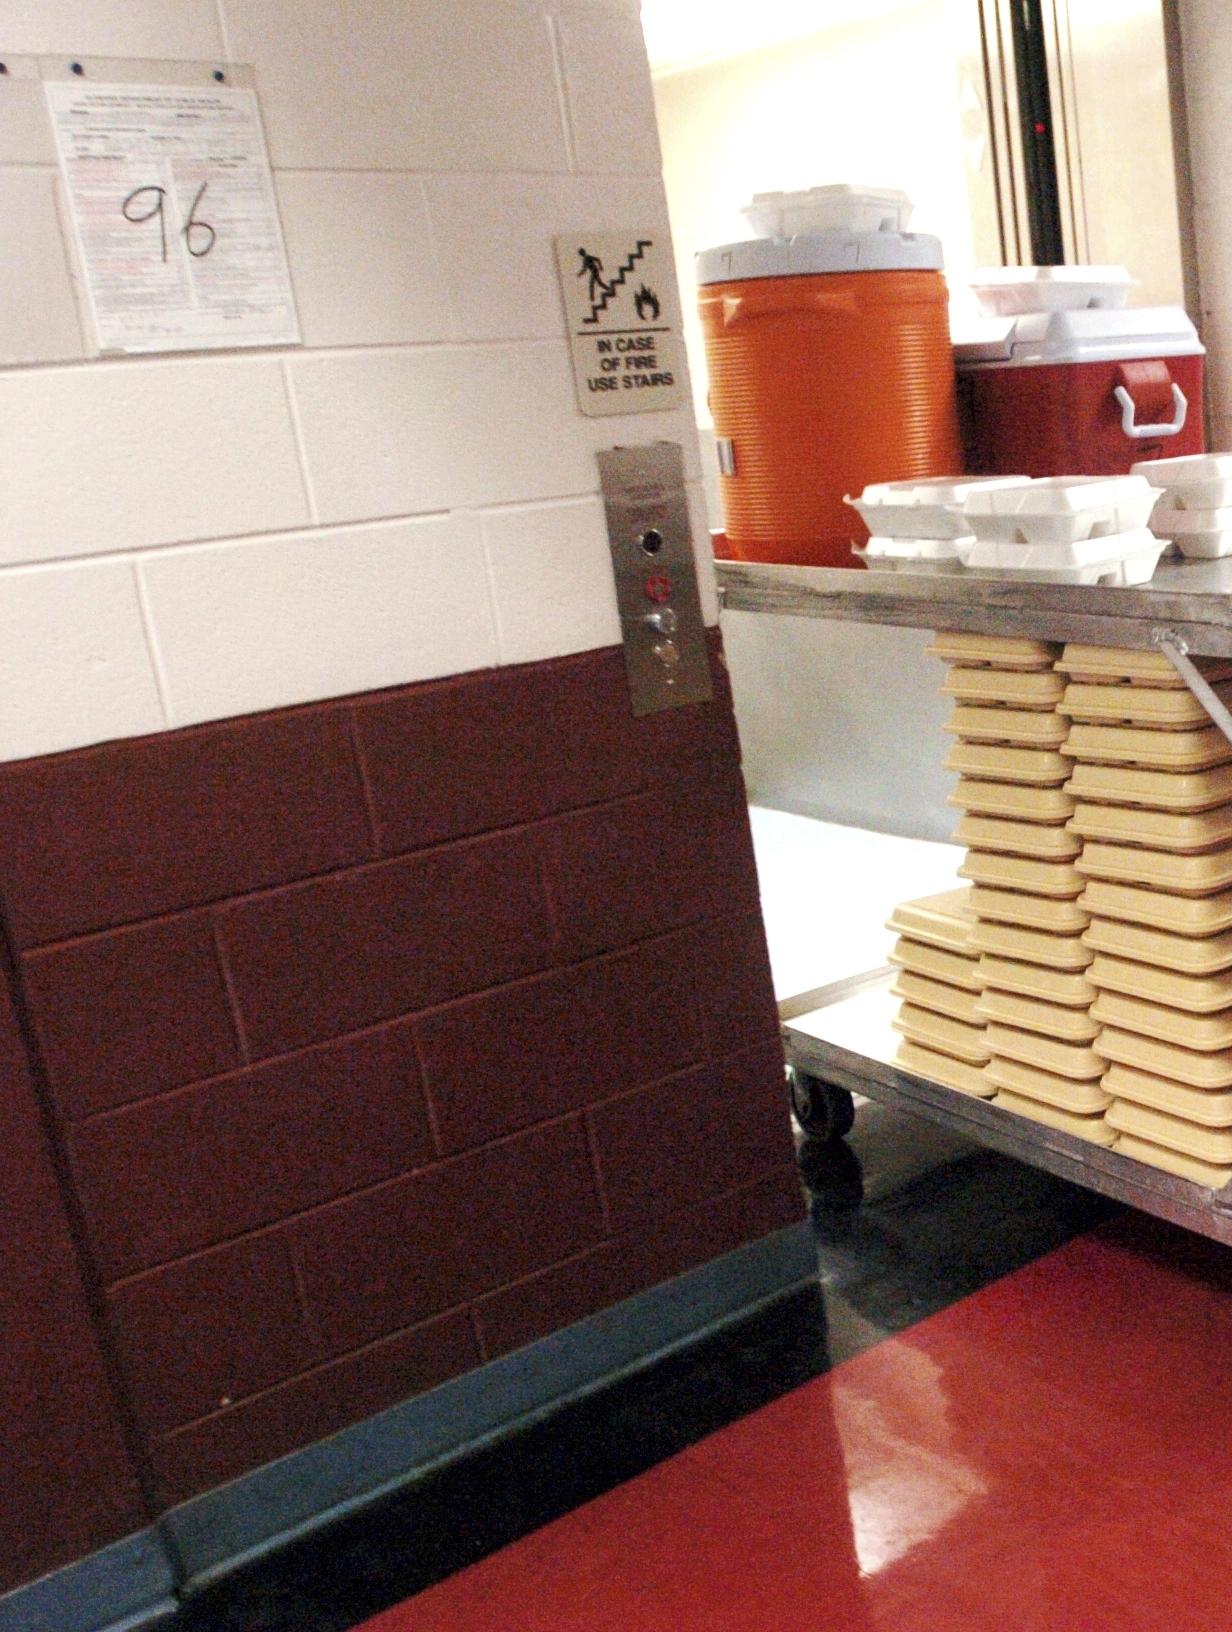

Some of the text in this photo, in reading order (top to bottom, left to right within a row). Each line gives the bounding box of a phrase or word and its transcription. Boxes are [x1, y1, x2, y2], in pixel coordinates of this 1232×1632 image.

[122, 181, 216, 263] 96
[597, 336, 655, 353] IN CASE
[601, 355, 657, 372] OF FIRE
[587, 372, 675, 392] USE STAIRS
